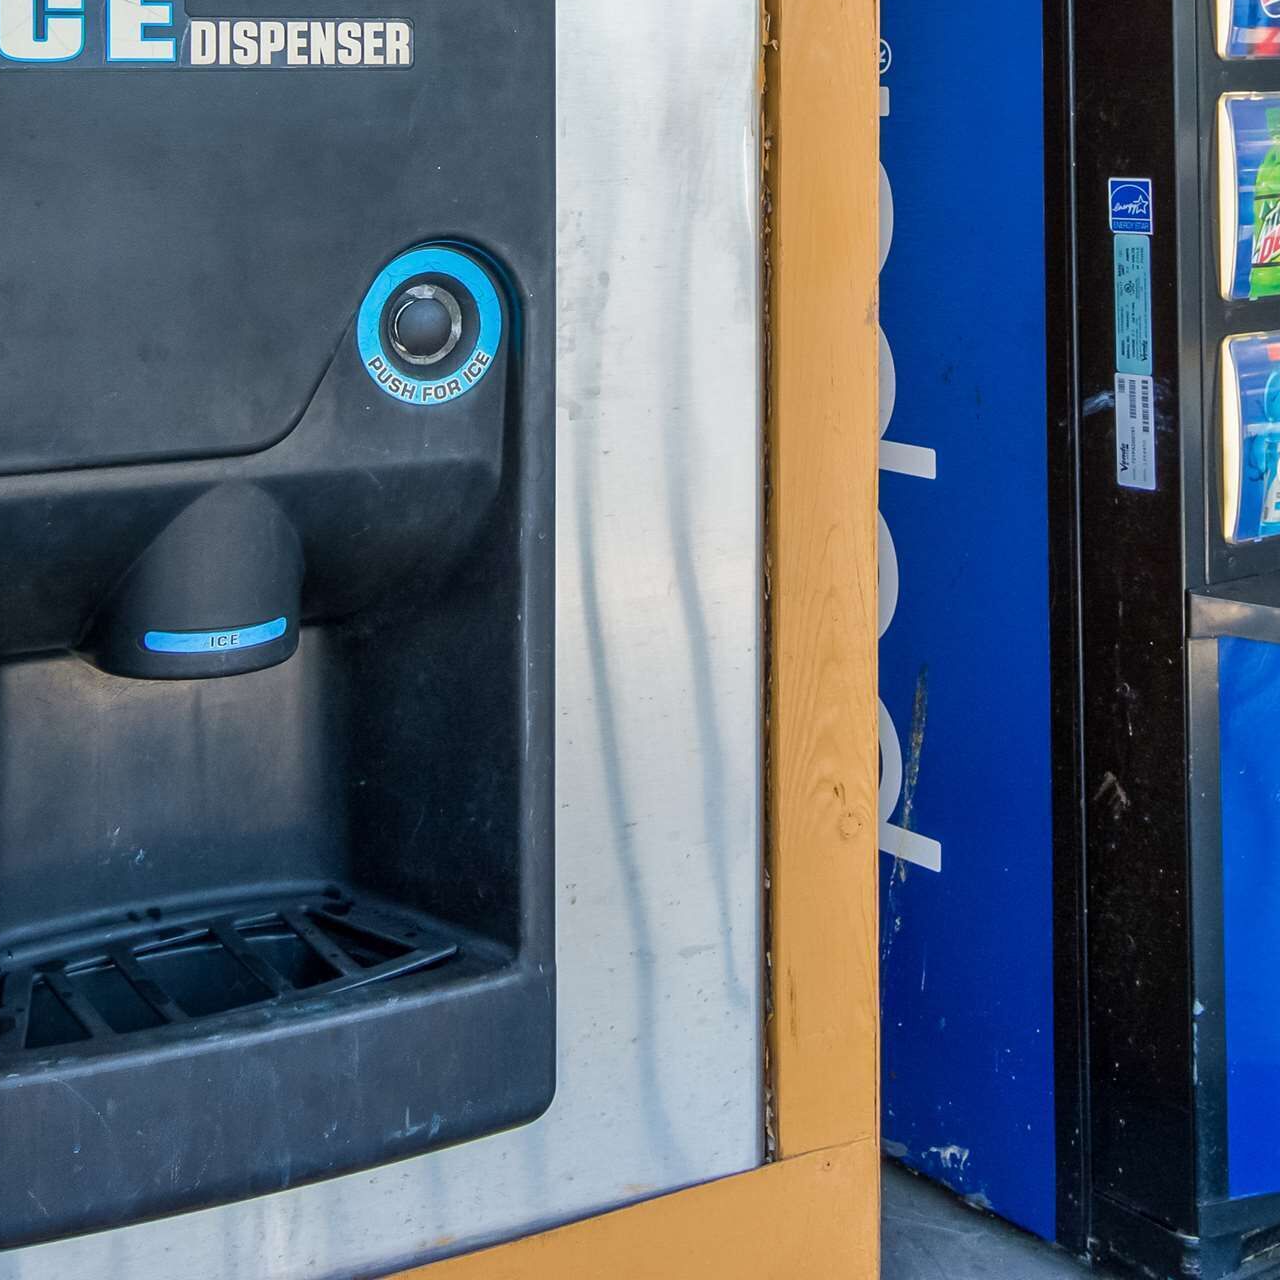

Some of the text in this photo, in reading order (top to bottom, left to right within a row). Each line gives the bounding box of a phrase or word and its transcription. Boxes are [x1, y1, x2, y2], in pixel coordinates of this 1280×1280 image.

[190, 20, 410, 65] DISPENSER
[368, 351, 491, 401] PUSH FOR ICE
[210, 633, 241, 647] ICE
